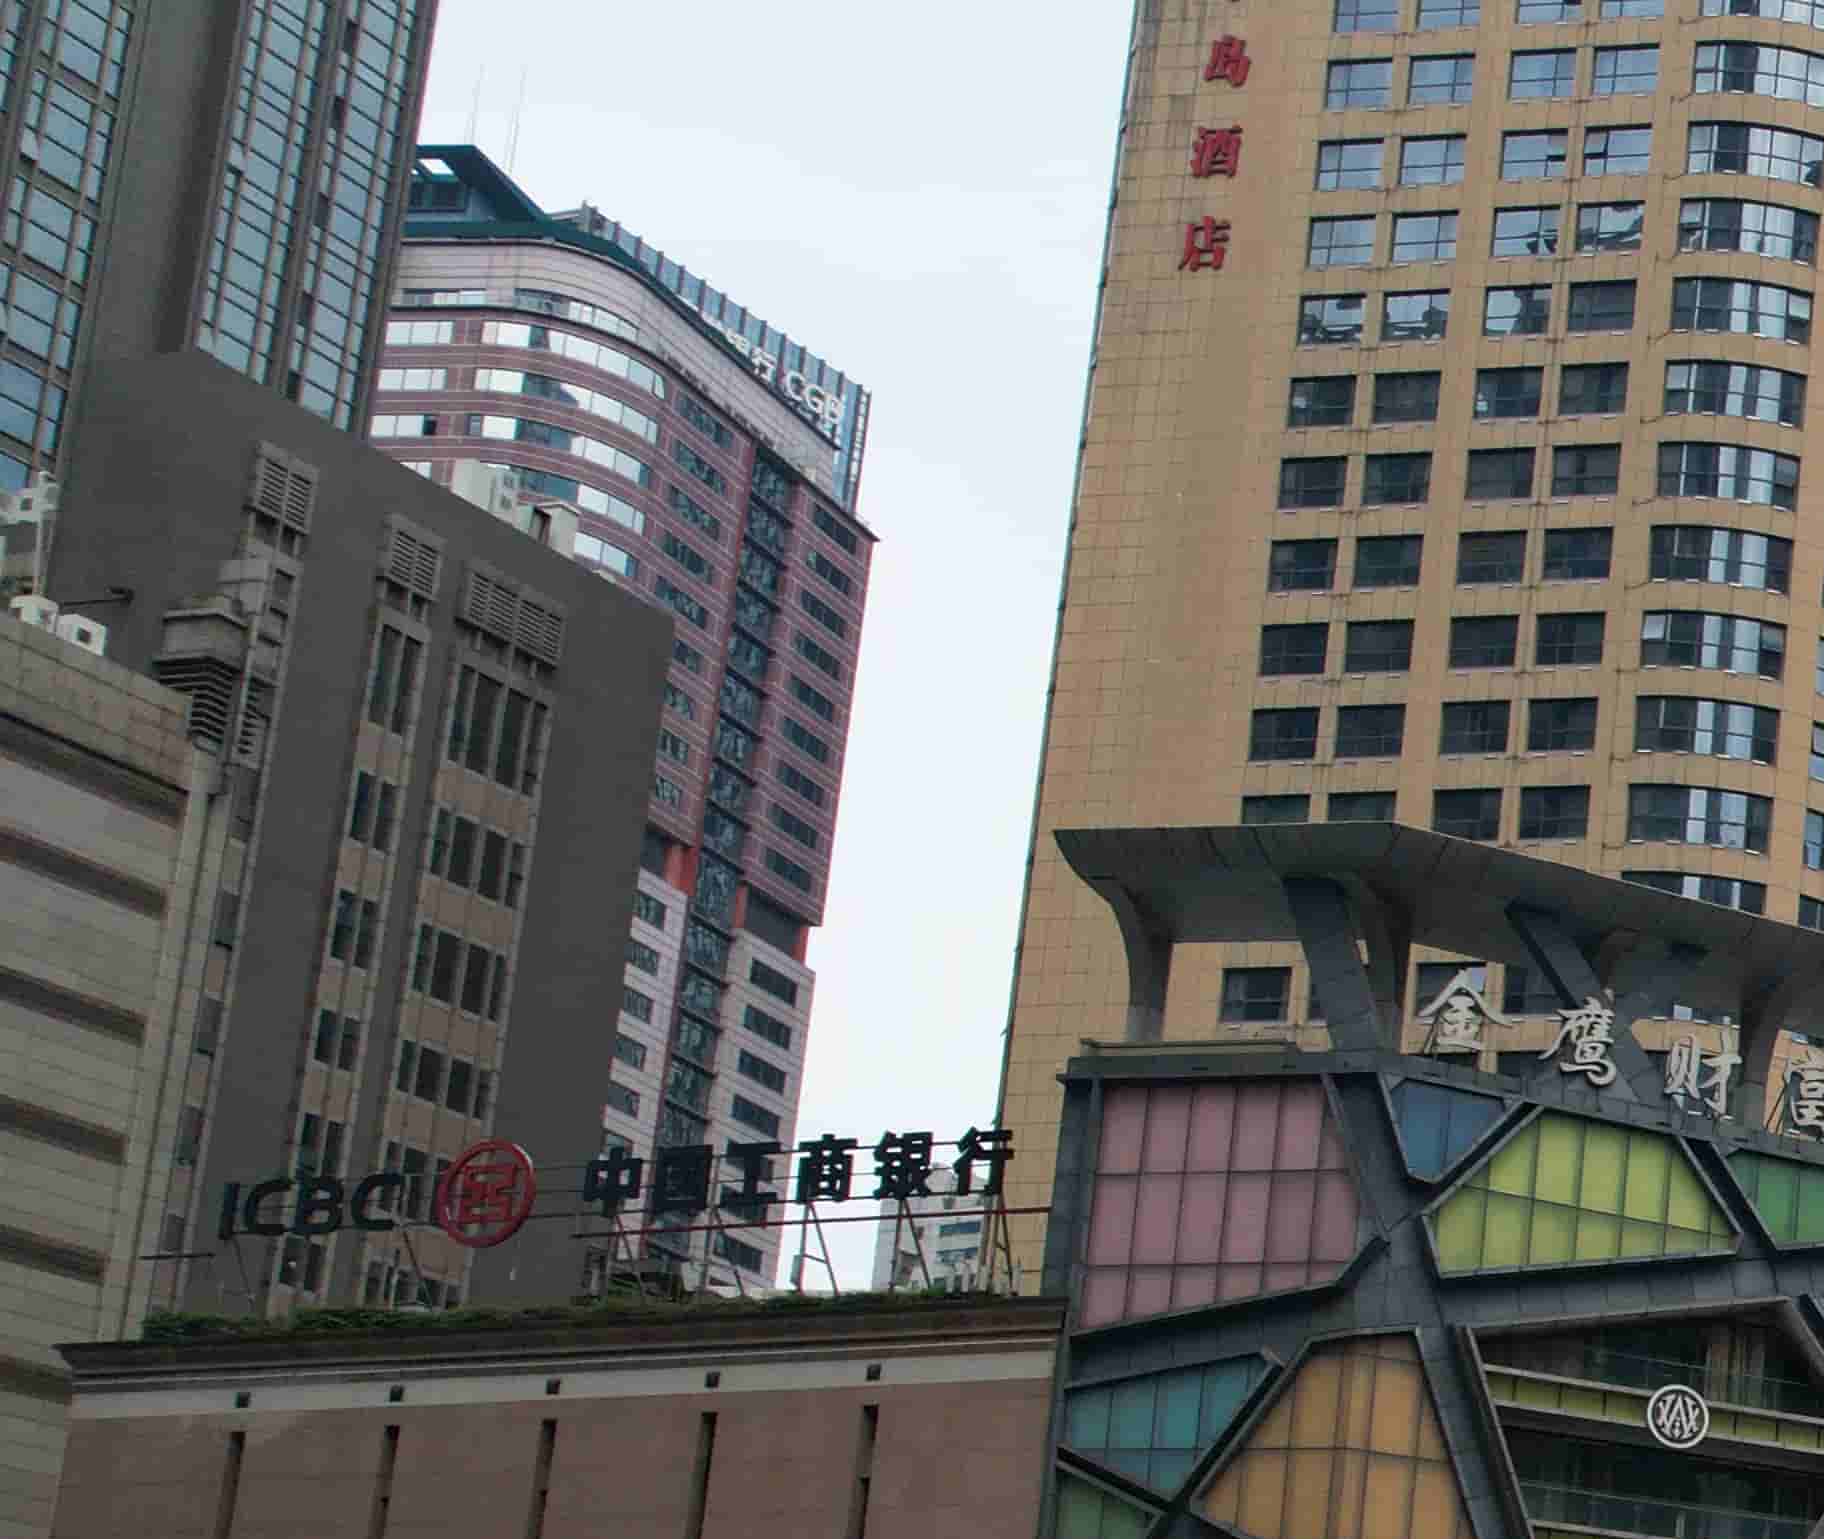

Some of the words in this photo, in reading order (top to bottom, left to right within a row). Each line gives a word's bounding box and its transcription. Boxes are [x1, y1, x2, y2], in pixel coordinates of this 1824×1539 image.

[218, 1172, 404, 1240] ICBC
[583, 1127, 1016, 1218] 中国工商银行
